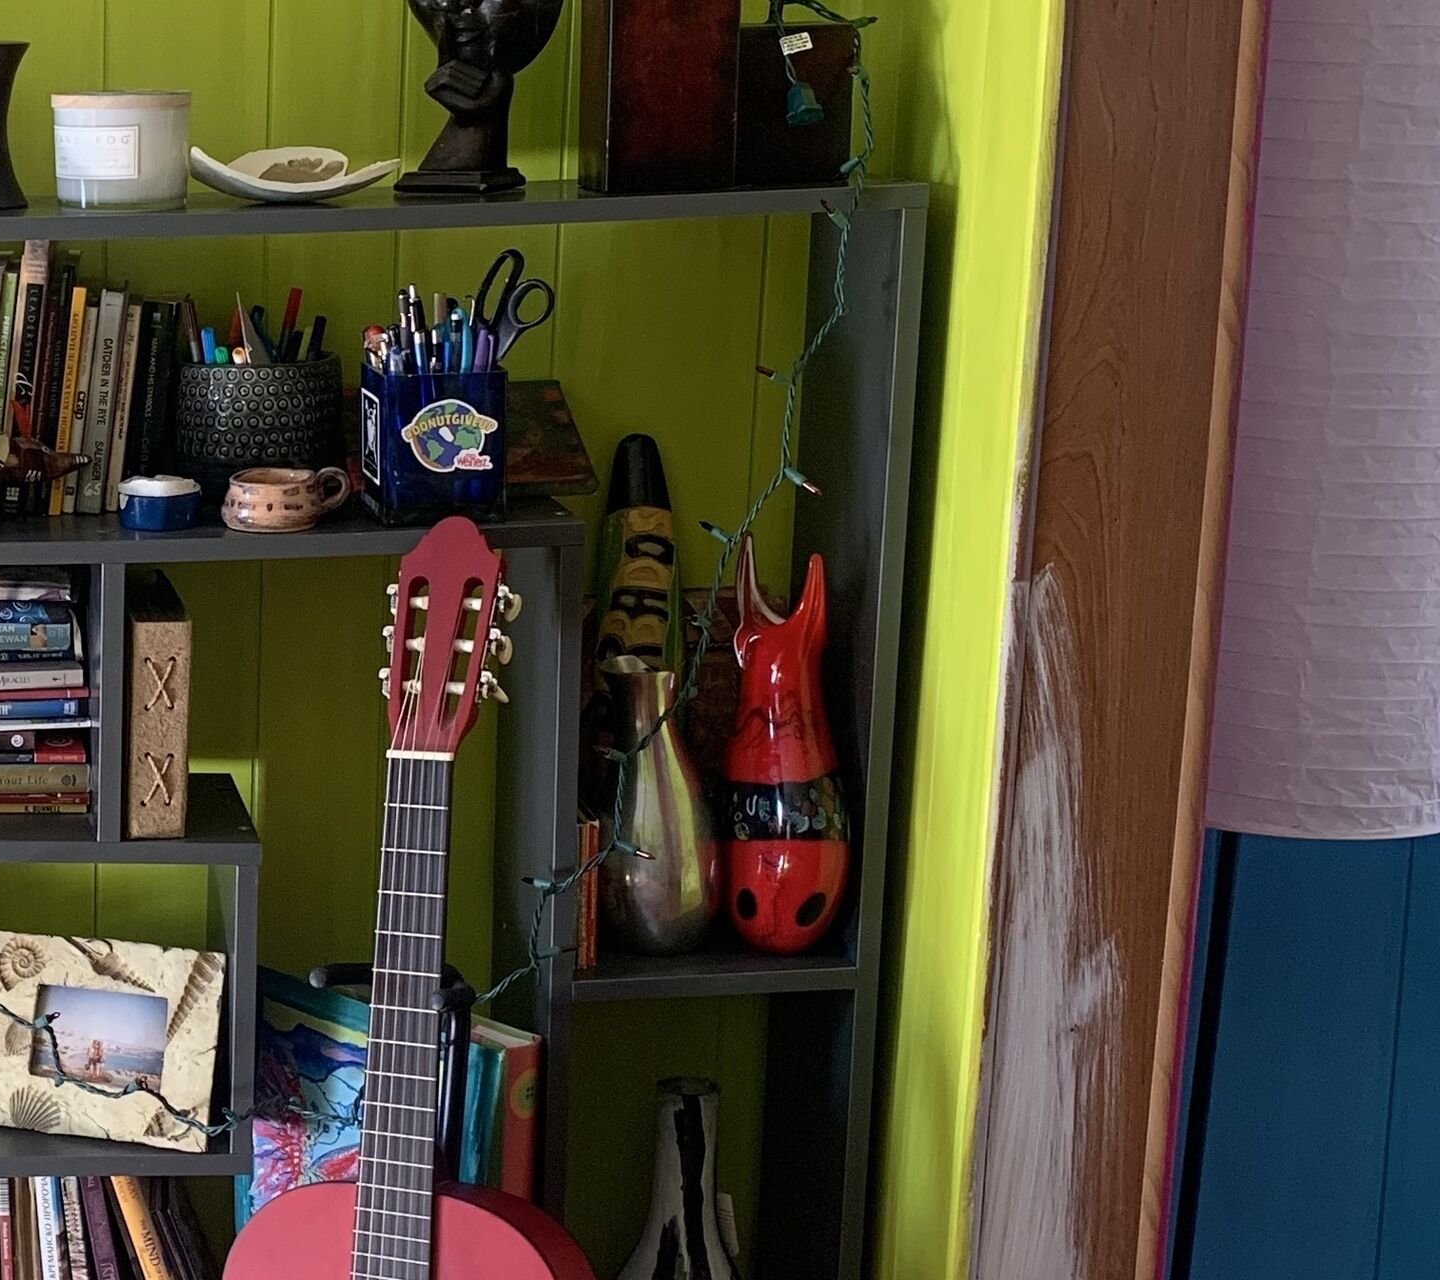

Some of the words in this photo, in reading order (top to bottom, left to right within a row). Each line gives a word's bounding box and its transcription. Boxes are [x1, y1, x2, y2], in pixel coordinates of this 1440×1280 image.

[1, 316, 10, 350] PERFECT
[21, 288, 39, 372] LEADERSHIP
[101, 338, 114, 376] CATCHER
[98, 390, 109, 406] THE
[99, 378, 110, 388] IN
[96, 408, 109, 426] RYE
[92, 441, 105, 481] SALINGER
[27, 773, 50, 786] Life
[141, 1231, 160, 1267] MIND
